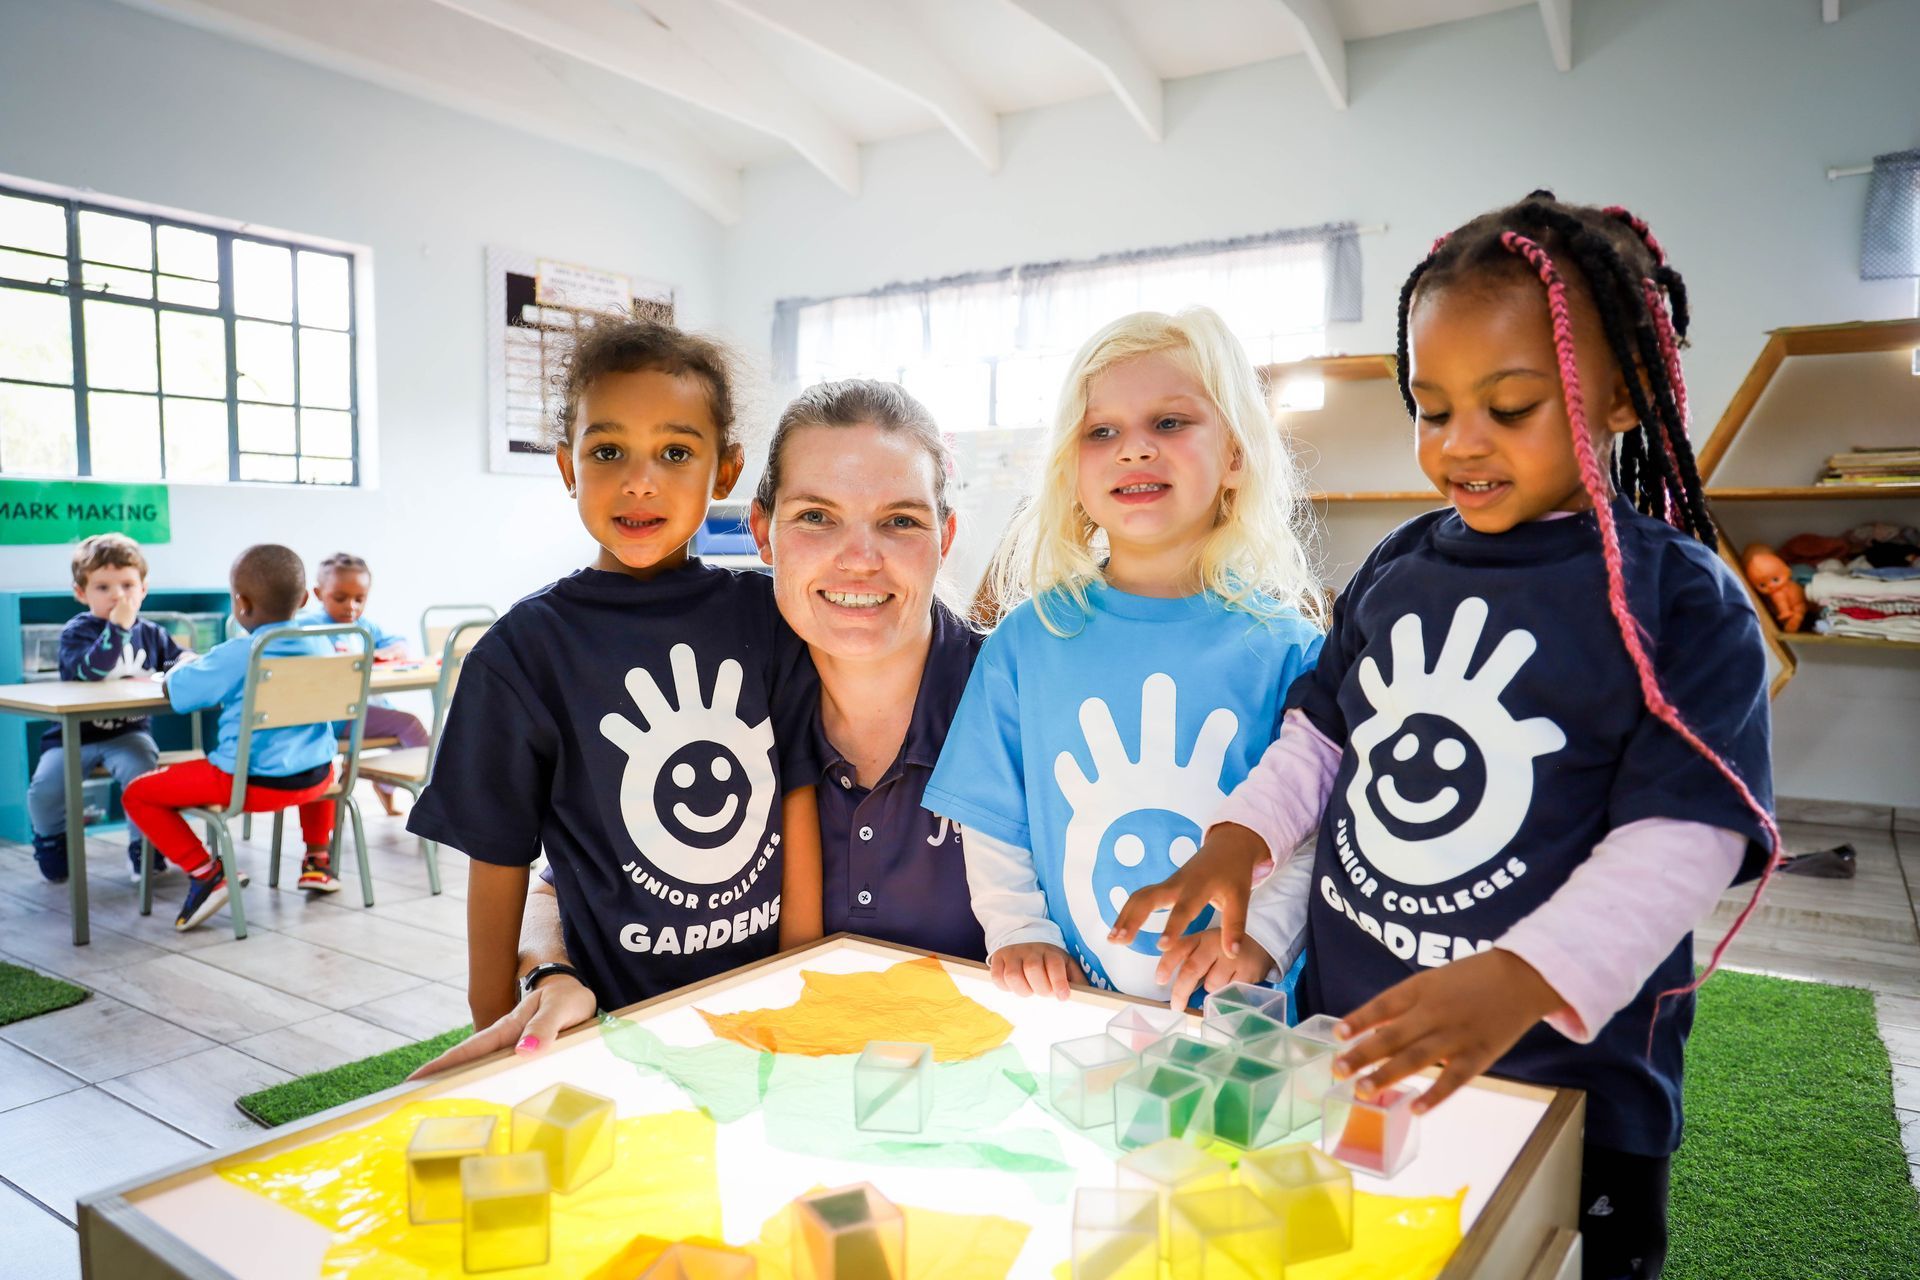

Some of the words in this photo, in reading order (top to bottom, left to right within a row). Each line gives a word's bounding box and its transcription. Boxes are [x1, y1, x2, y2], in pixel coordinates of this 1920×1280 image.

[0, 502, 59, 520] MARK
[67, 503, 158, 522] MAKING
[622, 860, 699, 910] JUNIOR
[708, 832, 781, 910] COLLEGES
[1336, 818, 1379, 898] JUNIOR
[1382, 857, 1528, 915] COLLEGES
[619, 894, 781, 955] GARDENS
[1320, 875, 1494, 968] GARDEN
